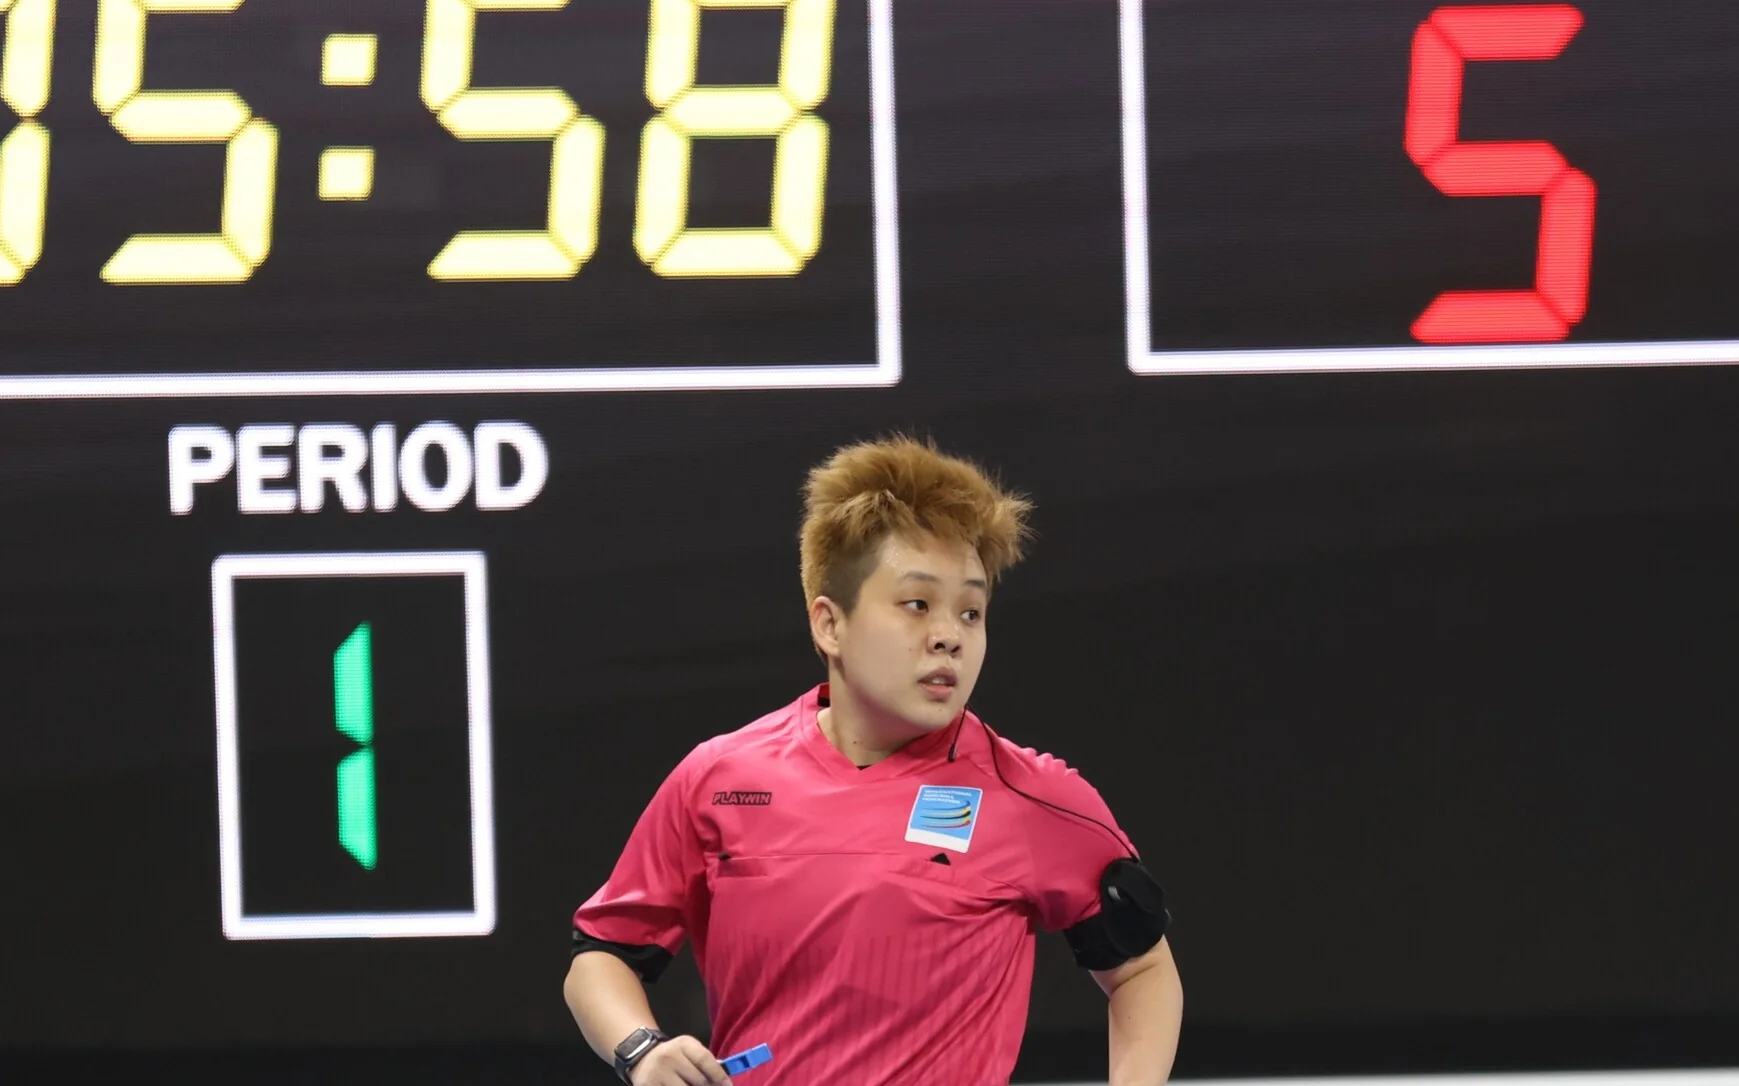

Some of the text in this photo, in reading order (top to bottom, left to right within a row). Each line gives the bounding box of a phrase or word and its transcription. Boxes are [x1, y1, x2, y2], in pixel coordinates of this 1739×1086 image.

[1404, 4, 1597, 343] 5
[168, 420, 549, 515] PERIOD
[333, 620, 378, 871] 1
[712, 791, 772, 806] PLAYWIN
